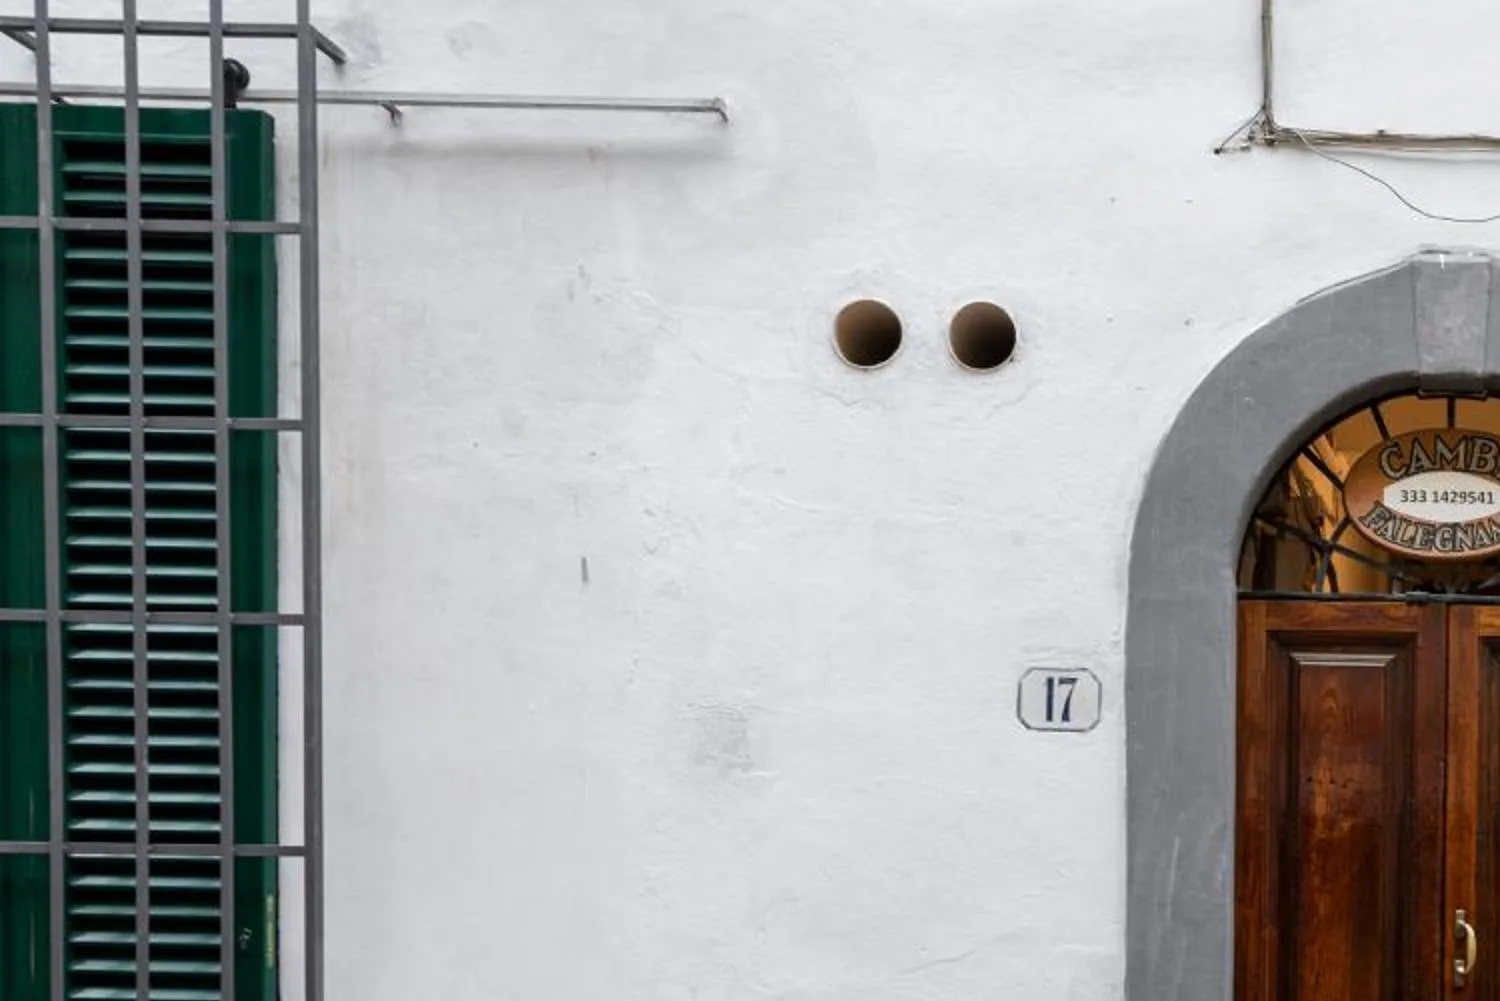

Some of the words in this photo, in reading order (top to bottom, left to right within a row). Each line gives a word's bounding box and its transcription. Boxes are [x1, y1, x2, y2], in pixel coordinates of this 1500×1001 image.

[1401, 489, 1427, 503] 333
[1432, 490, 1495, 505] 1429541
[1045, 676, 1078, 722] 17
